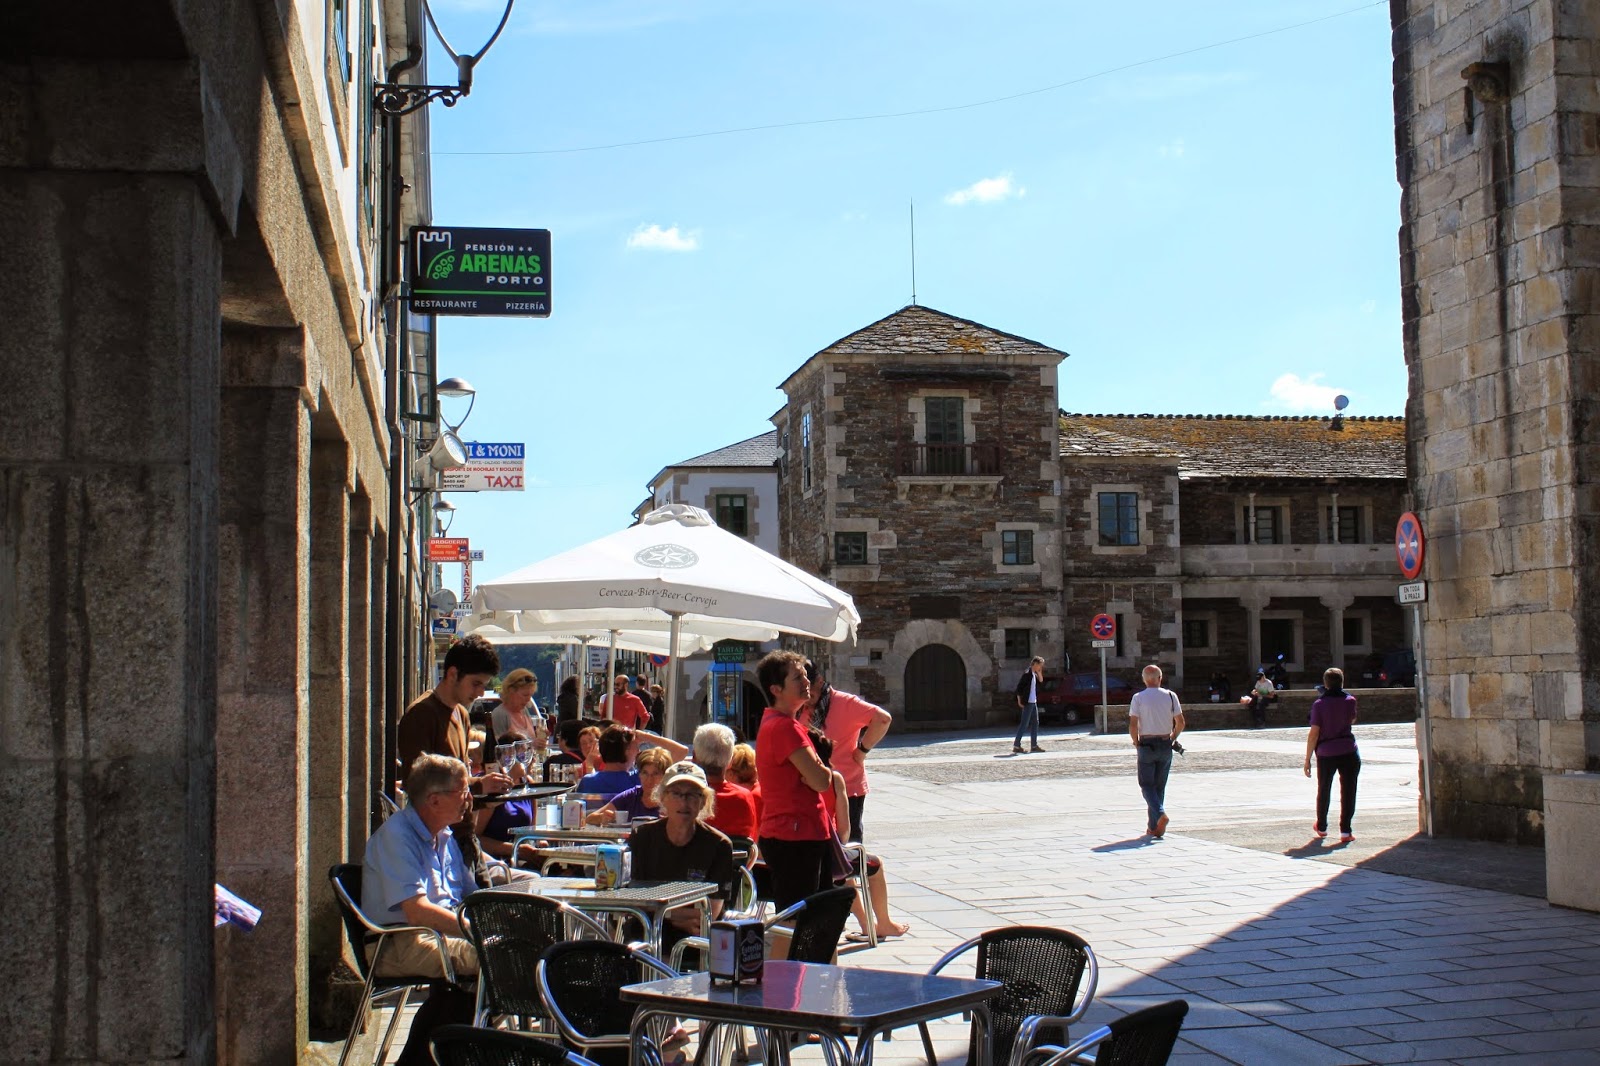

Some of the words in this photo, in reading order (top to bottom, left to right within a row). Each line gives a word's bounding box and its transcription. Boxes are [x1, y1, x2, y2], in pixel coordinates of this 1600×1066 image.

[465, 243, 514, 252] PENSIÓN
[460, 254, 541, 274] ARENAS
[486, 276, 544, 285] PORTO
[414, 300, 477, 309] RESTAURANTE
[506, 302, 545, 311] PIZZERÍA
[476, 445, 486, 457] &
[488, 445, 522, 457] MONI
[484, 475, 523, 488] TAXI
